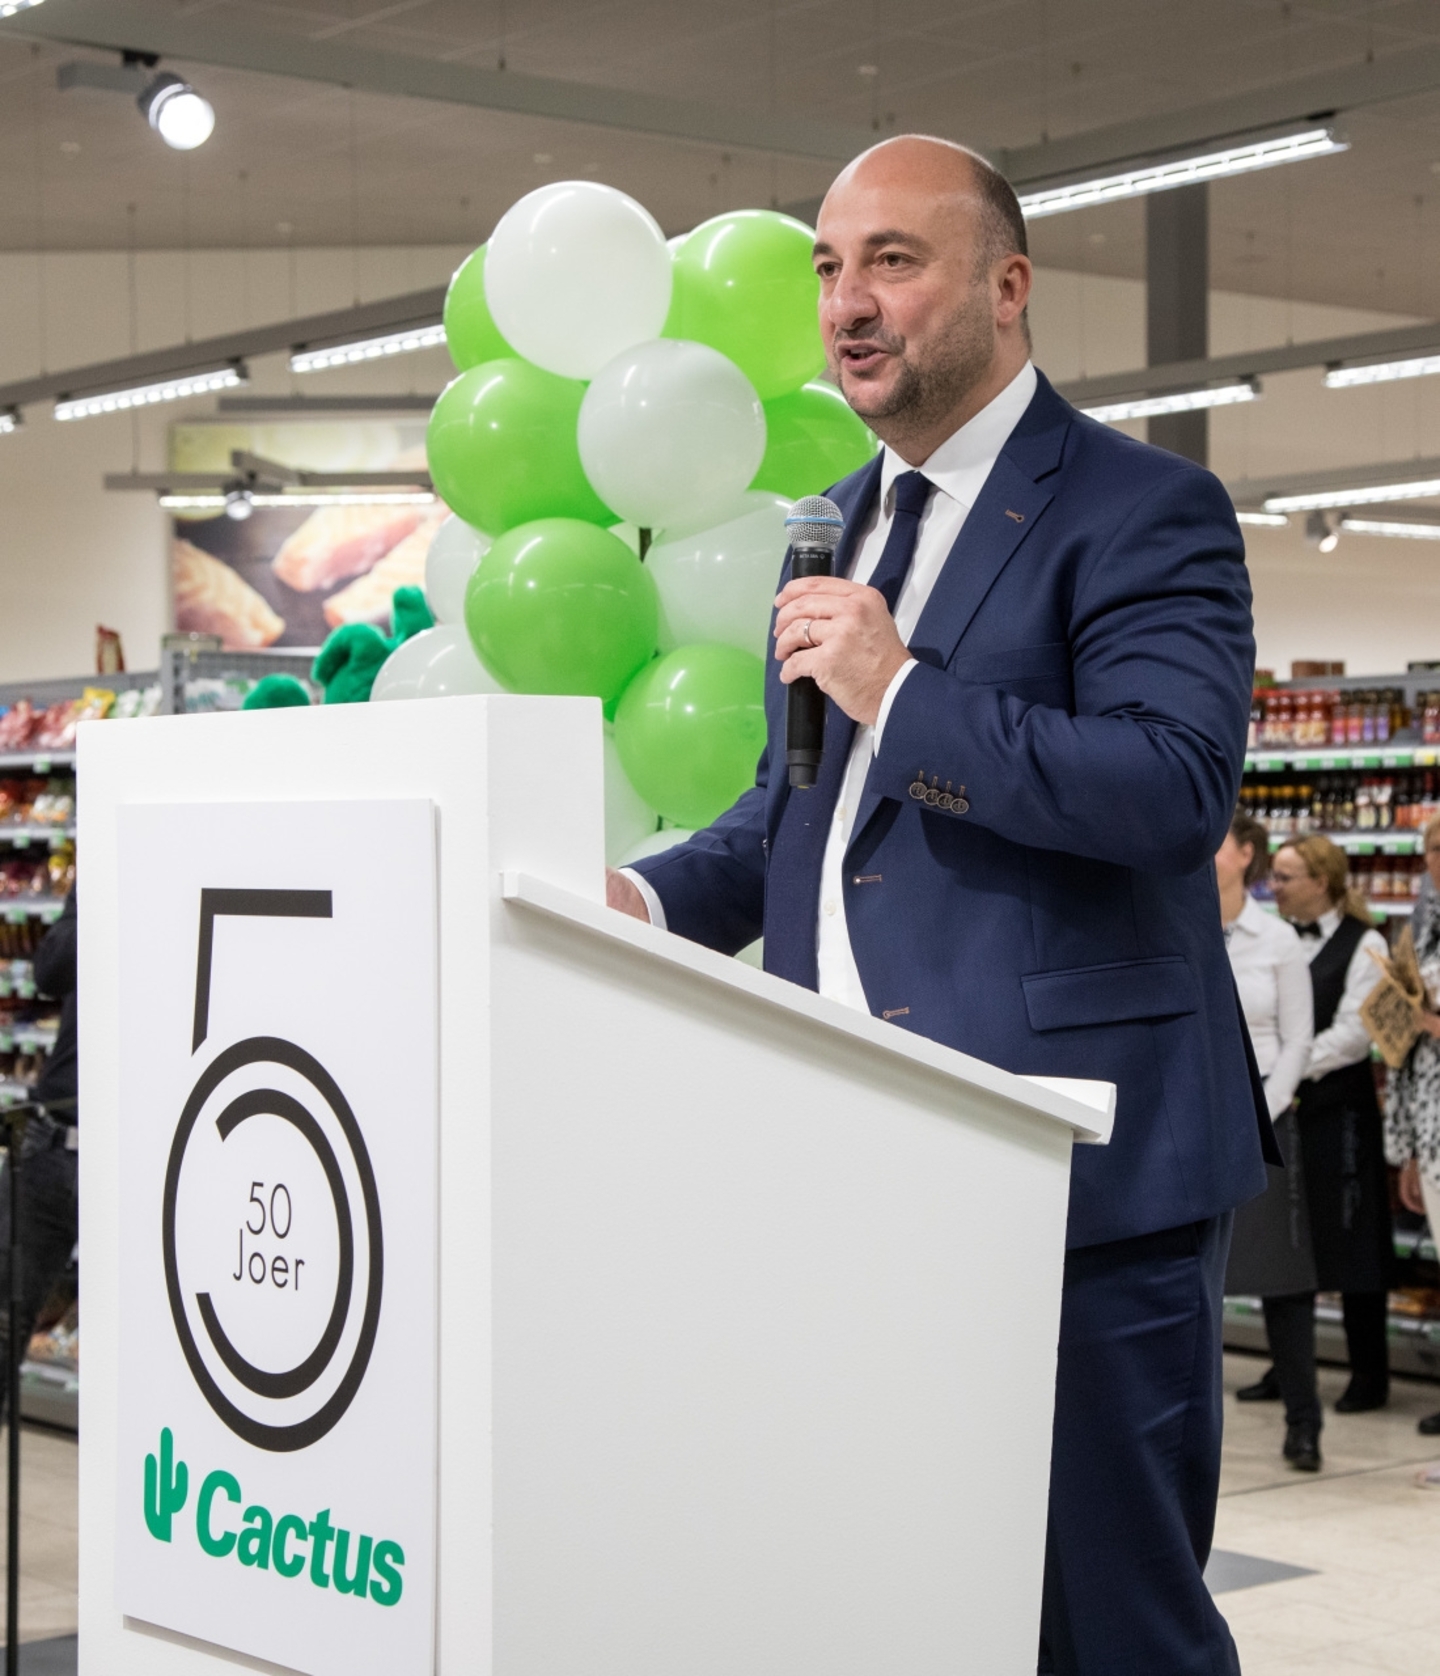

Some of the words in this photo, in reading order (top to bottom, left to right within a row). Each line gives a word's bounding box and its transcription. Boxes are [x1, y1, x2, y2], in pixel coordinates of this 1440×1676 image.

[246, 1181, 292, 1239] 50
[232, 1229, 305, 1291] Joer
[196, 1470, 405, 1607] Cactus
